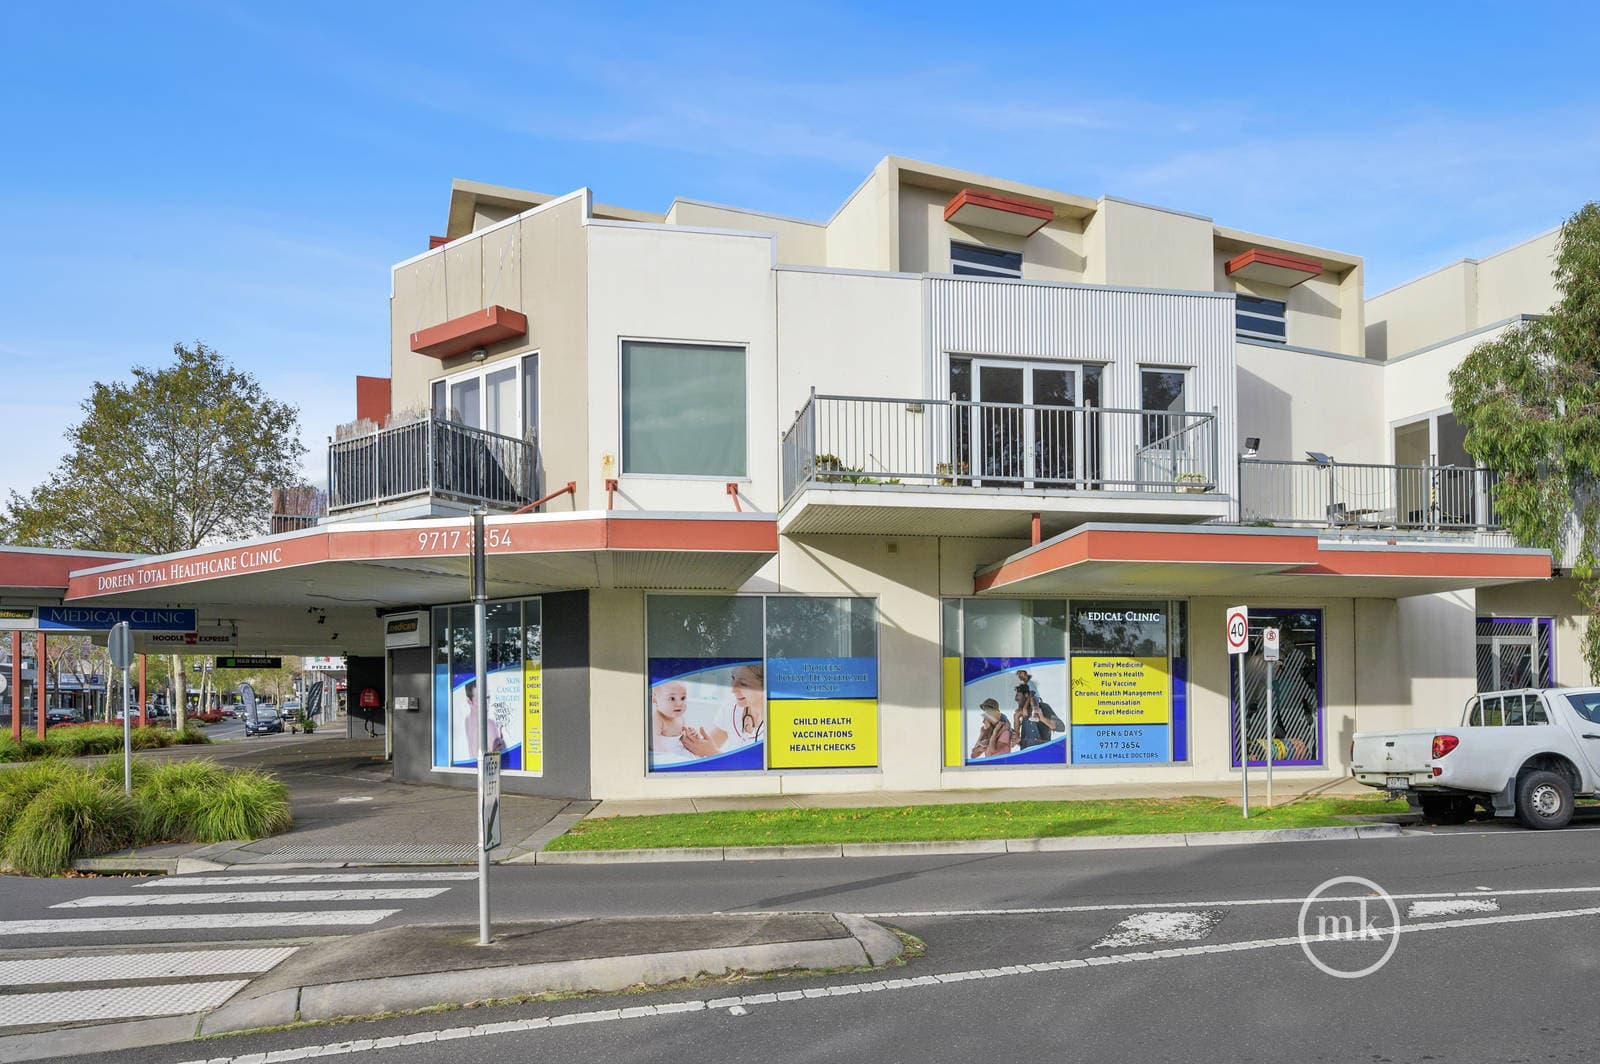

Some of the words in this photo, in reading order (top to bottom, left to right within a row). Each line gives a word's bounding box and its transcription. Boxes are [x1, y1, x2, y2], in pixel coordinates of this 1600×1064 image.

[418, 531, 460, 550] 9717
[466, 529, 512, 548] 354
[98, 573, 134, 591] DOREEN
[138, 569, 168, 585] TOTAL
[170, 556, 236, 580] HEALTHCARE
[240, 548, 282, 568] CLINIC
[50, 609, 121, 622] MEDICAL
[130, 610, 184, 624] CLINIC
[1125, 611, 1160, 622] CLINIC
[1230, 622, 1244, 638] 40
